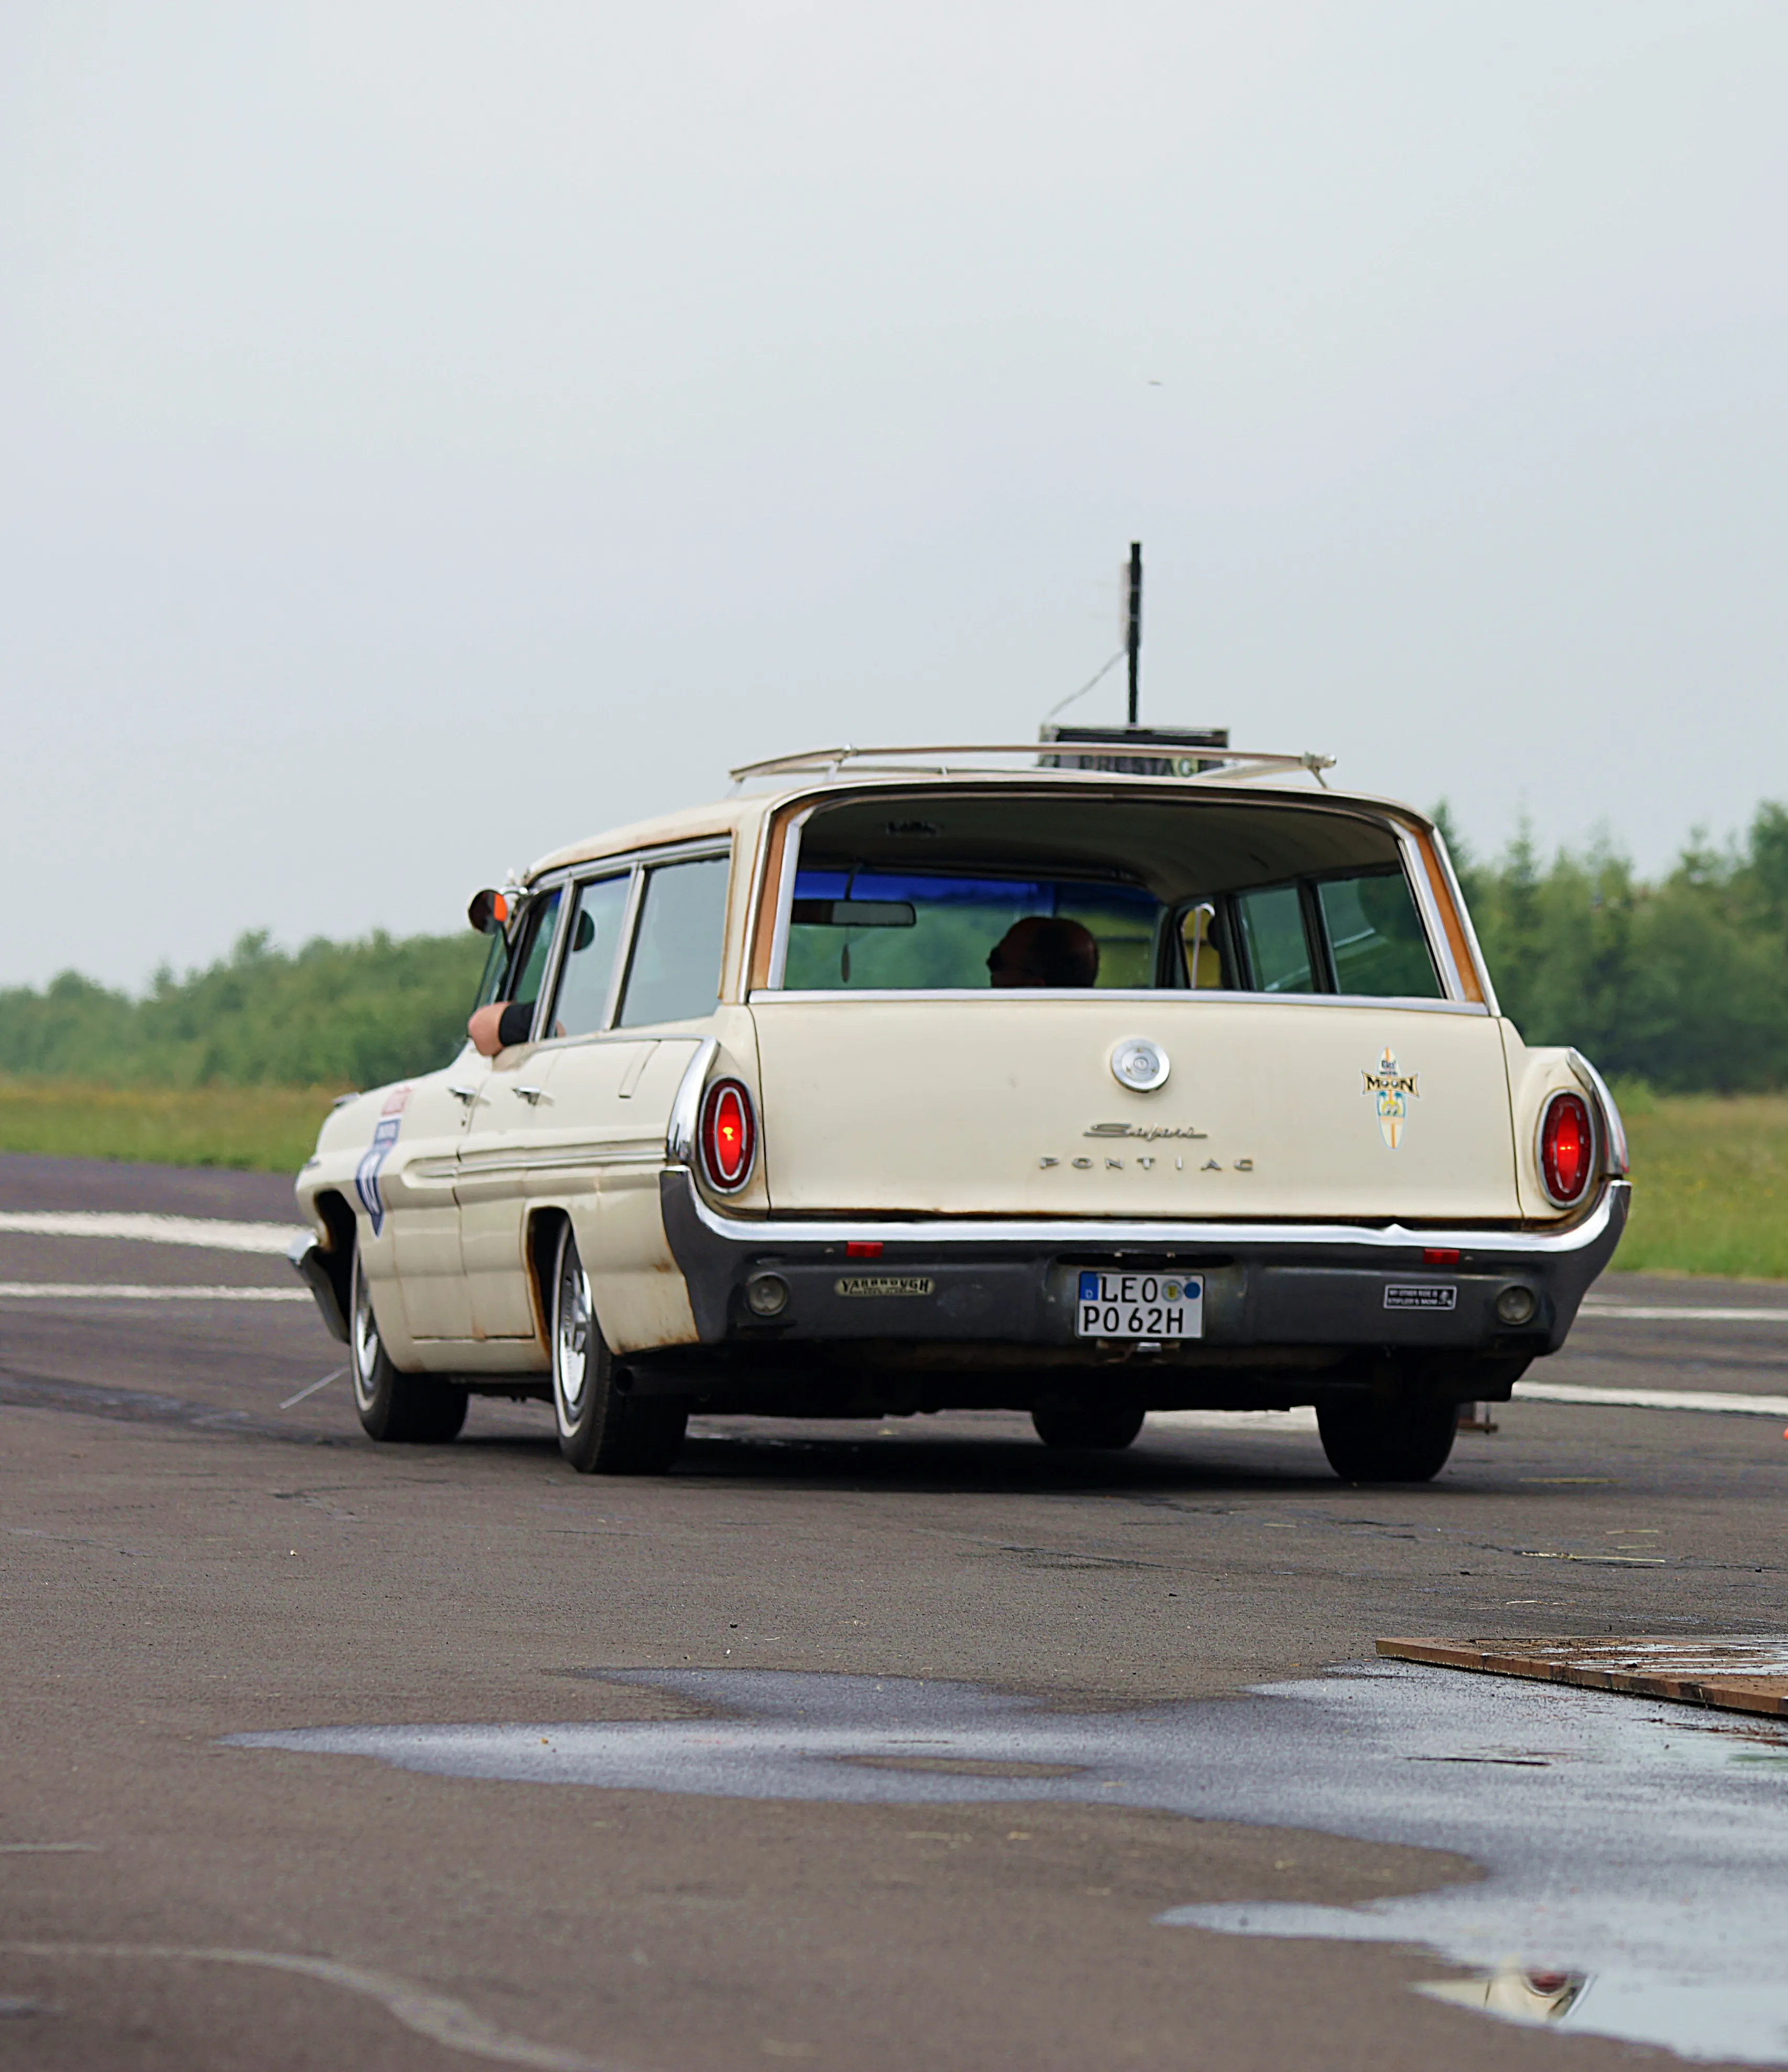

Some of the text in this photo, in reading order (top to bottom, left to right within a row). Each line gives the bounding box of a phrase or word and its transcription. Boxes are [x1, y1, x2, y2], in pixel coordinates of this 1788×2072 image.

[1367, 1076, 1414, 1092] MOON
[1083, 1123, 1208, 1141] Safari
[1039, 1156, 1253, 1172] PONTIAC
[1102, 1276, 1158, 1303] LEO
[1083, 1306, 1183, 1334] PO 62H
